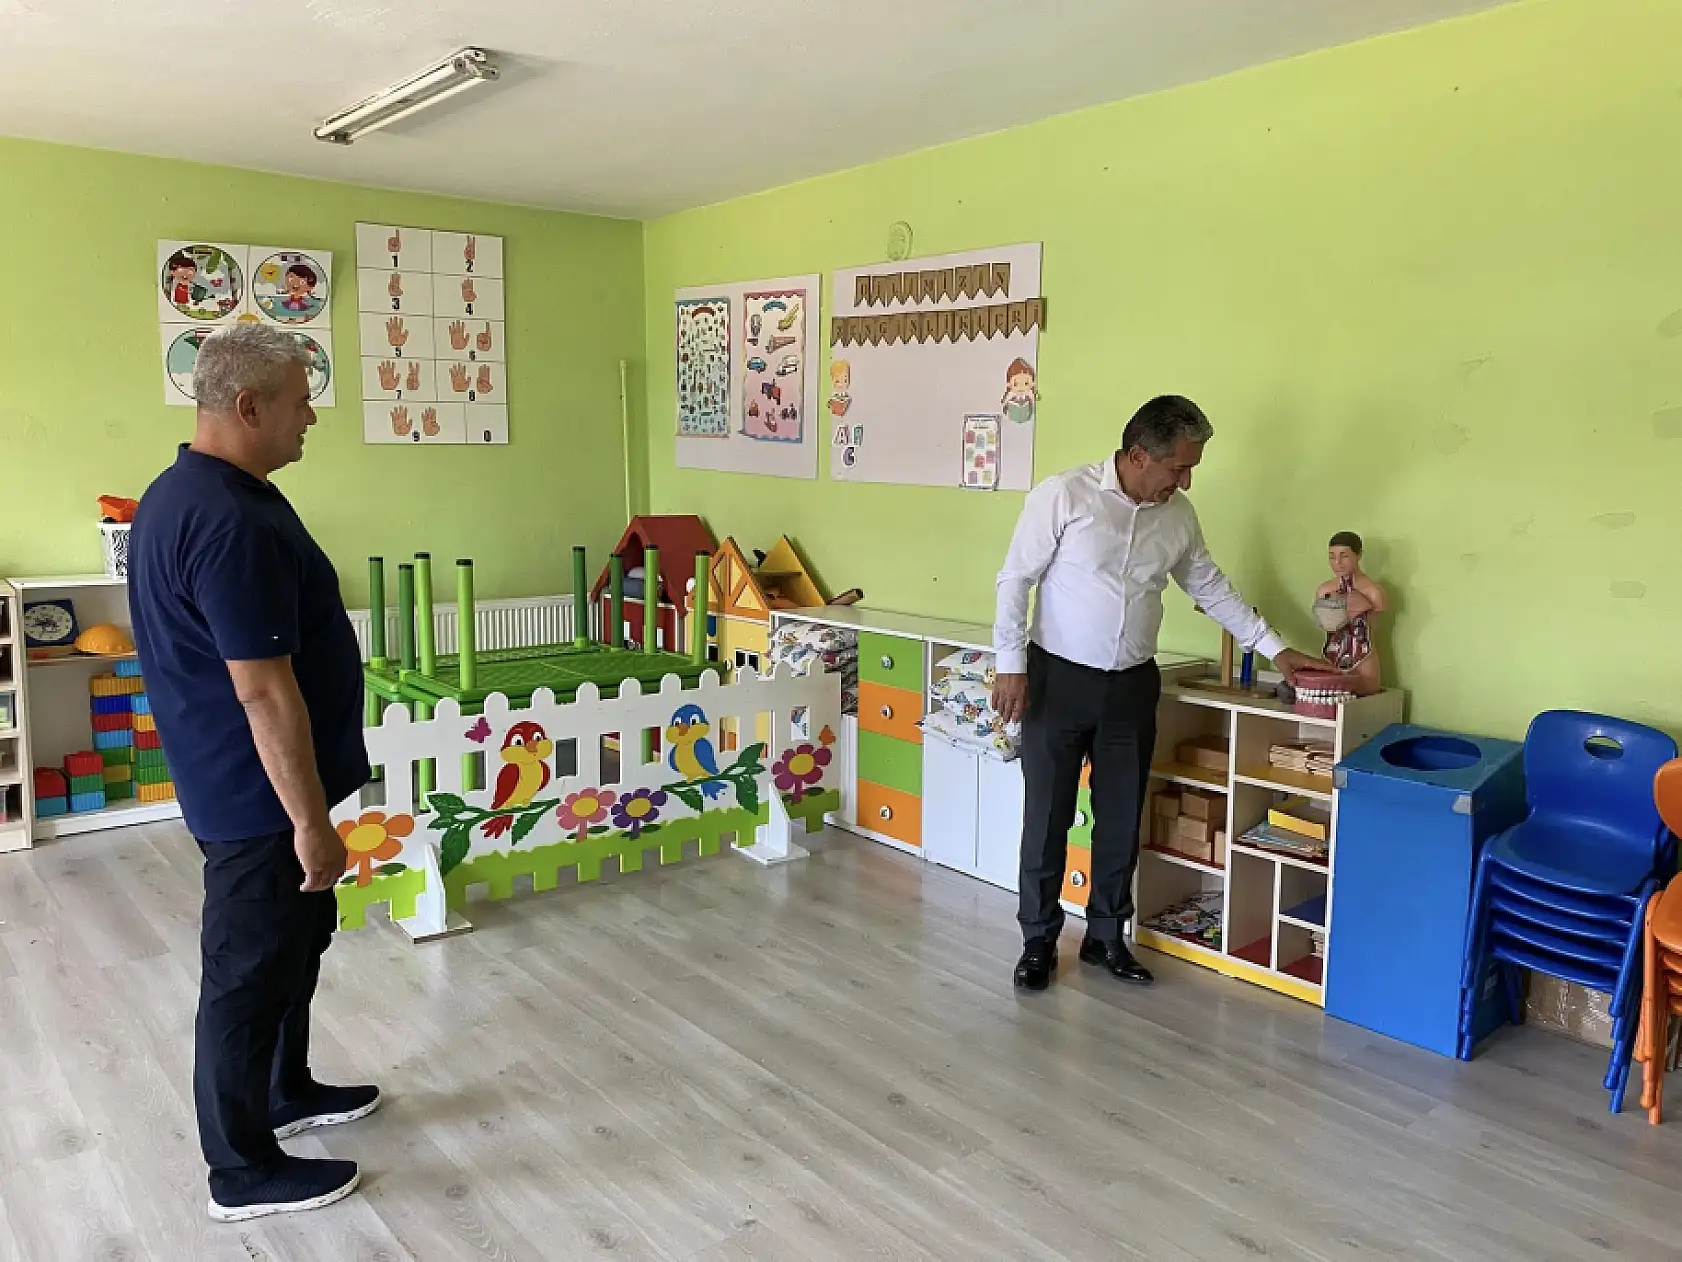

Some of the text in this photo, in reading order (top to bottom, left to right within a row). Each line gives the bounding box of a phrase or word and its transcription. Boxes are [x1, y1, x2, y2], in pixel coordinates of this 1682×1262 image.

[391, 255, 399, 268] 1
[466, 260, 474, 272] 2
[392, 297, 400, 310] 3
[465, 303, 474, 315] 4
[395, 347, 402, 358] 5
[468, 350, 476, 361] 6
[395, 390, 402, 400] 7
[468, 390, 476, 401] 8
[412, 431, 420, 442] 9
[483, 430, 492, 442] 0
